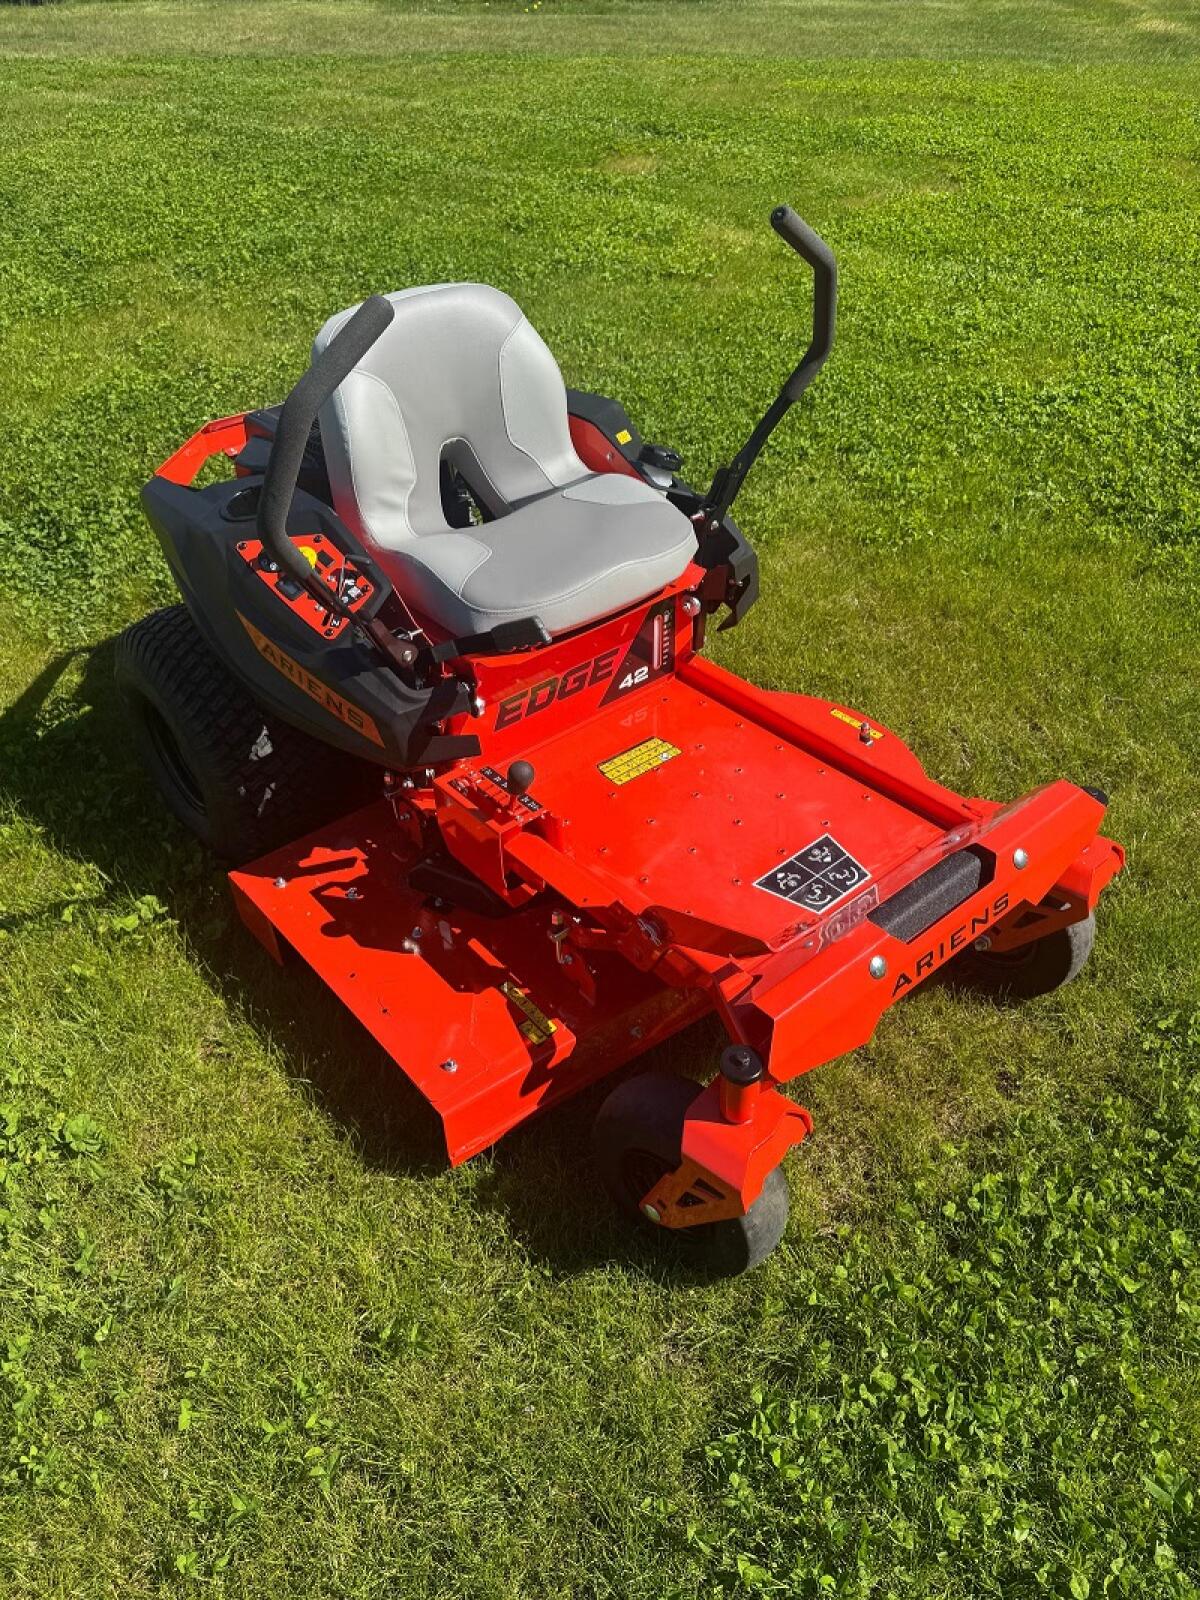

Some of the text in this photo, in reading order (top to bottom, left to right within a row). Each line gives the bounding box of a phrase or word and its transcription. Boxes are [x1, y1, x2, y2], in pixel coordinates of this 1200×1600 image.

[262, 641, 364, 729] ARIENS
[494, 646, 622, 732] EDGE
[618, 666, 649, 690] 42
[892, 892, 1009, 998] ARIENS
